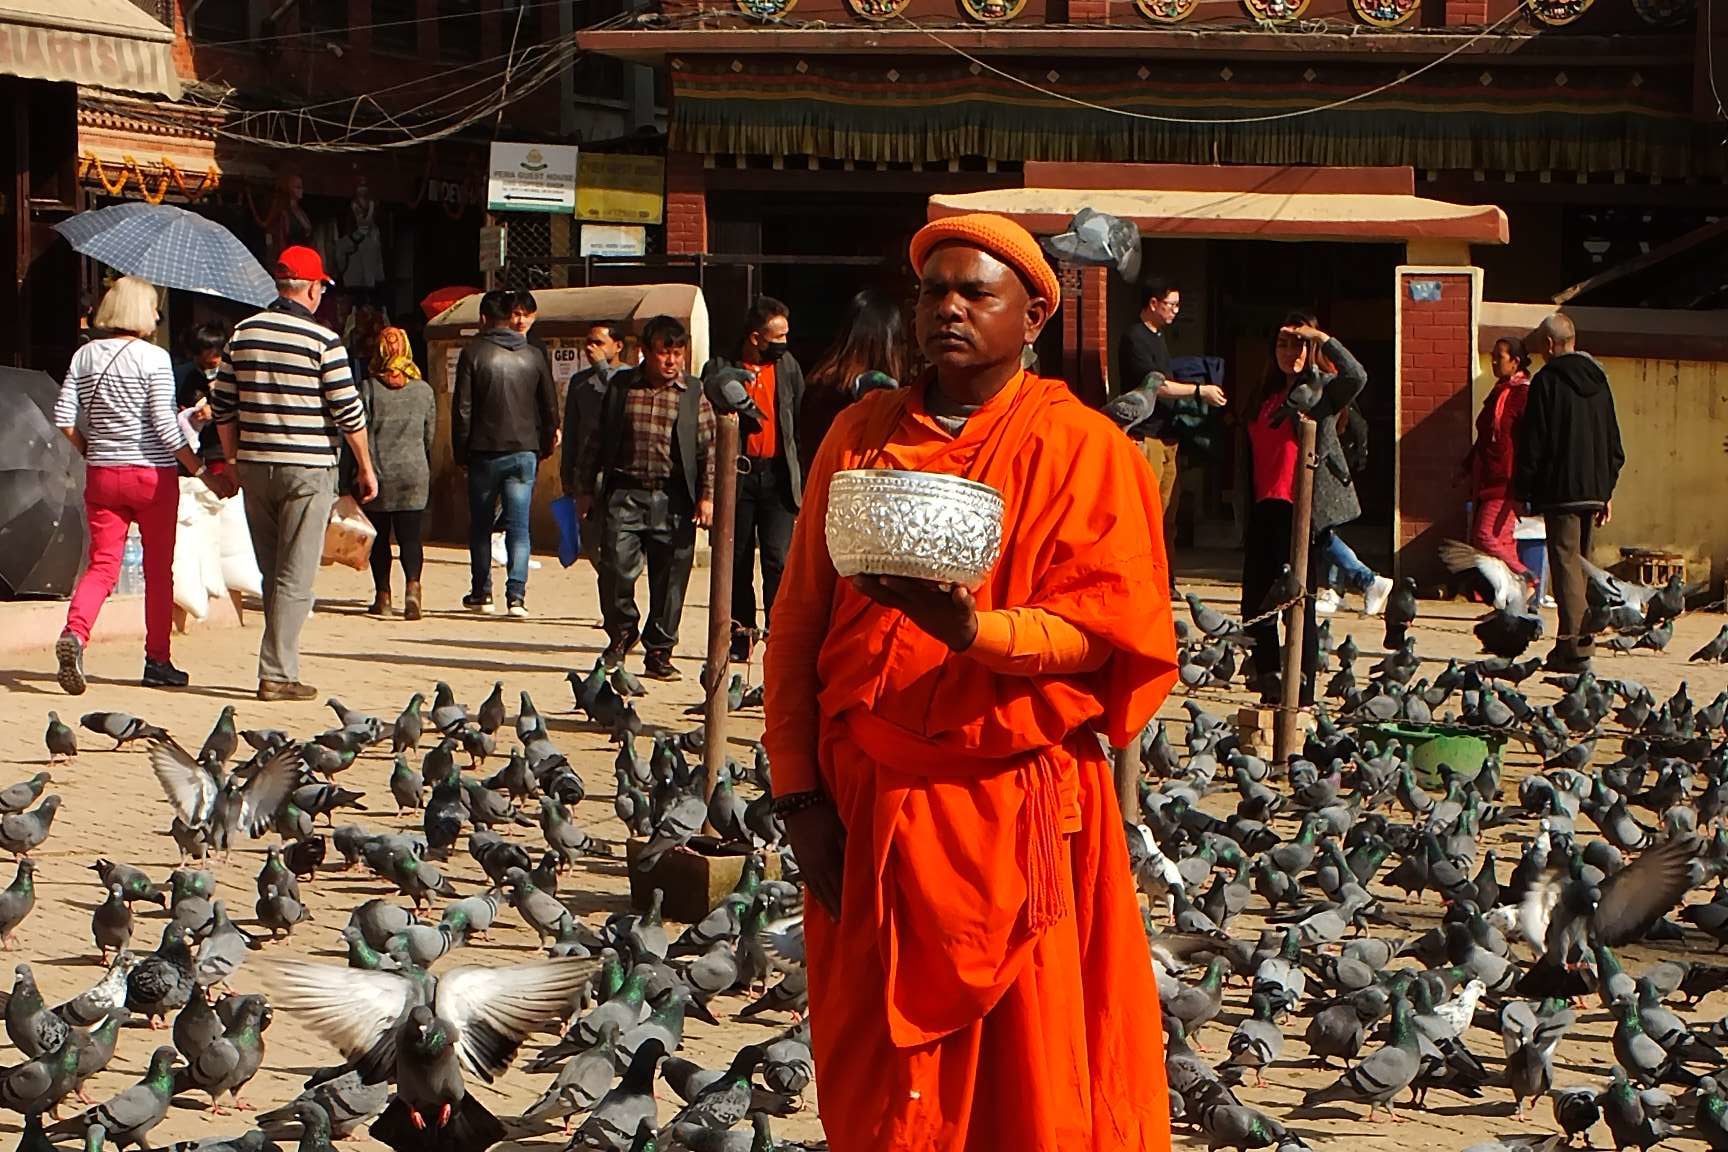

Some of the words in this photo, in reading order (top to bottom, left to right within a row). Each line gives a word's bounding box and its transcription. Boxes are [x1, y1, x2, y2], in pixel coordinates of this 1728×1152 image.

[517, 171, 544, 179] GUEST
[546, 173, 575, 181] HOUSE
[555, 350, 575, 361] GED
